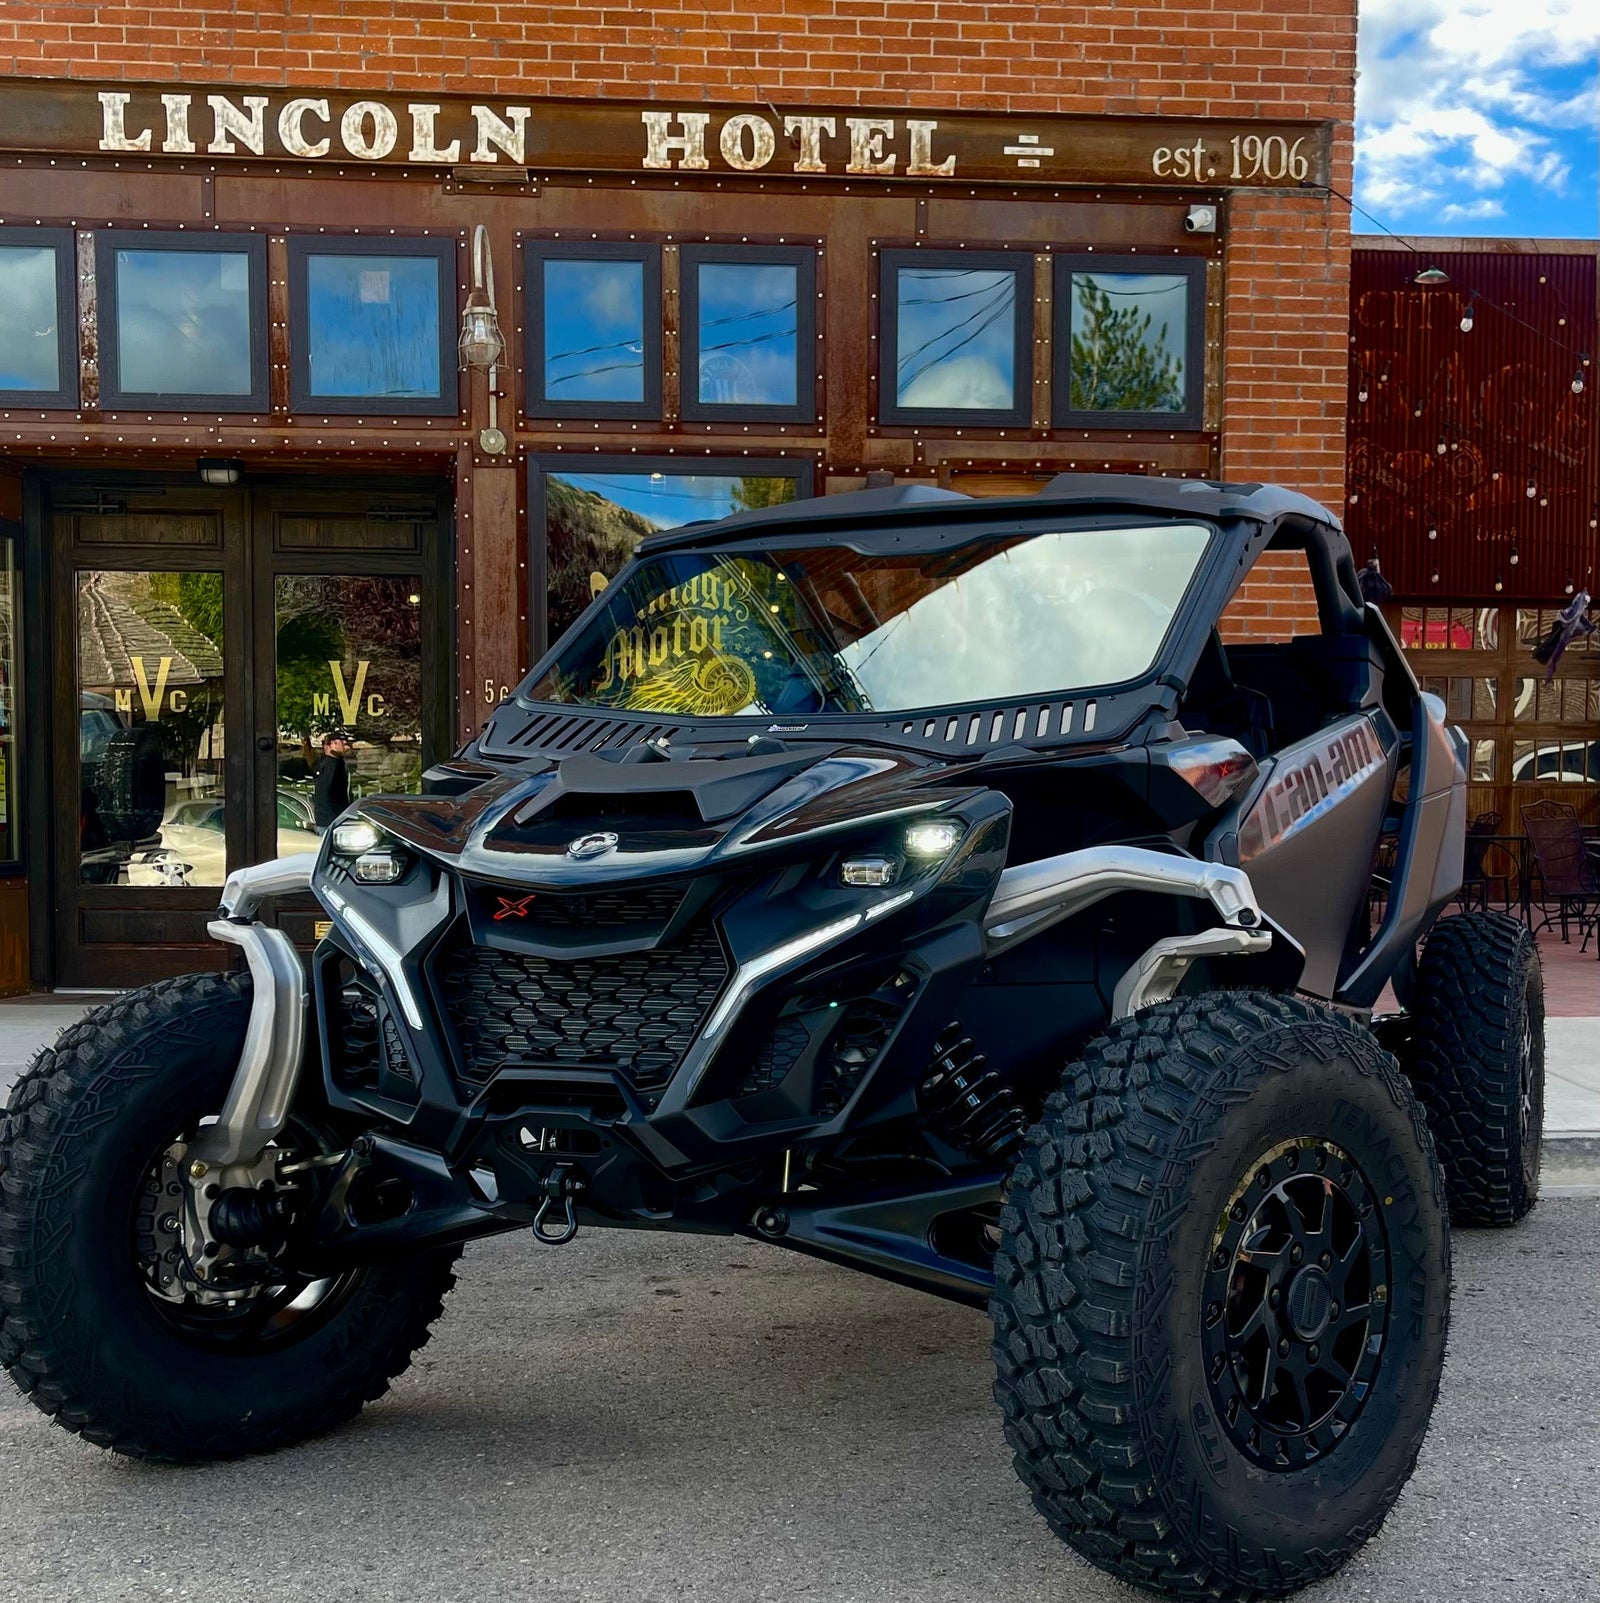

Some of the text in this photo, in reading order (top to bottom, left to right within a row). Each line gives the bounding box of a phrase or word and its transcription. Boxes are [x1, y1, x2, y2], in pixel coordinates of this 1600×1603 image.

[97, 91, 957, 177] LINCOLN HOTEL
[1152, 135, 1309, 183] est. 1906
[596, 613, 730, 693] Motor
